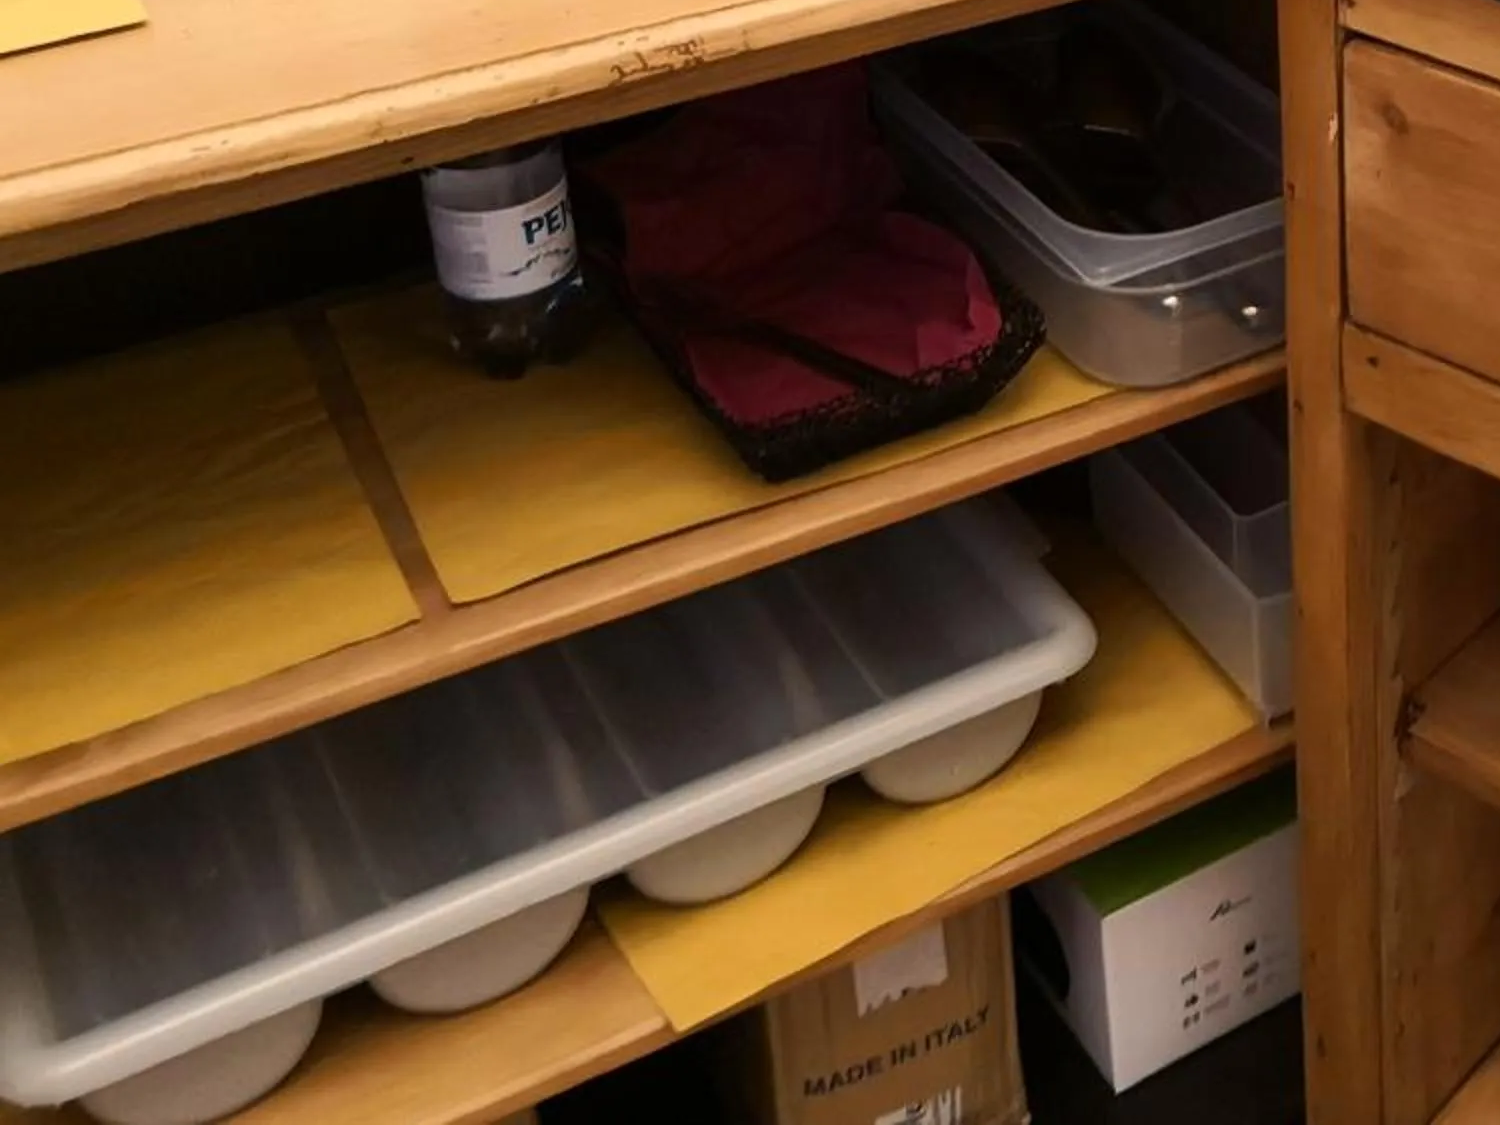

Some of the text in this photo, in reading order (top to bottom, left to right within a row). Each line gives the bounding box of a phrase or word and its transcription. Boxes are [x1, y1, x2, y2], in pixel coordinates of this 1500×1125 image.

[803, 1005, 990, 1097] MADE IN ITALY
